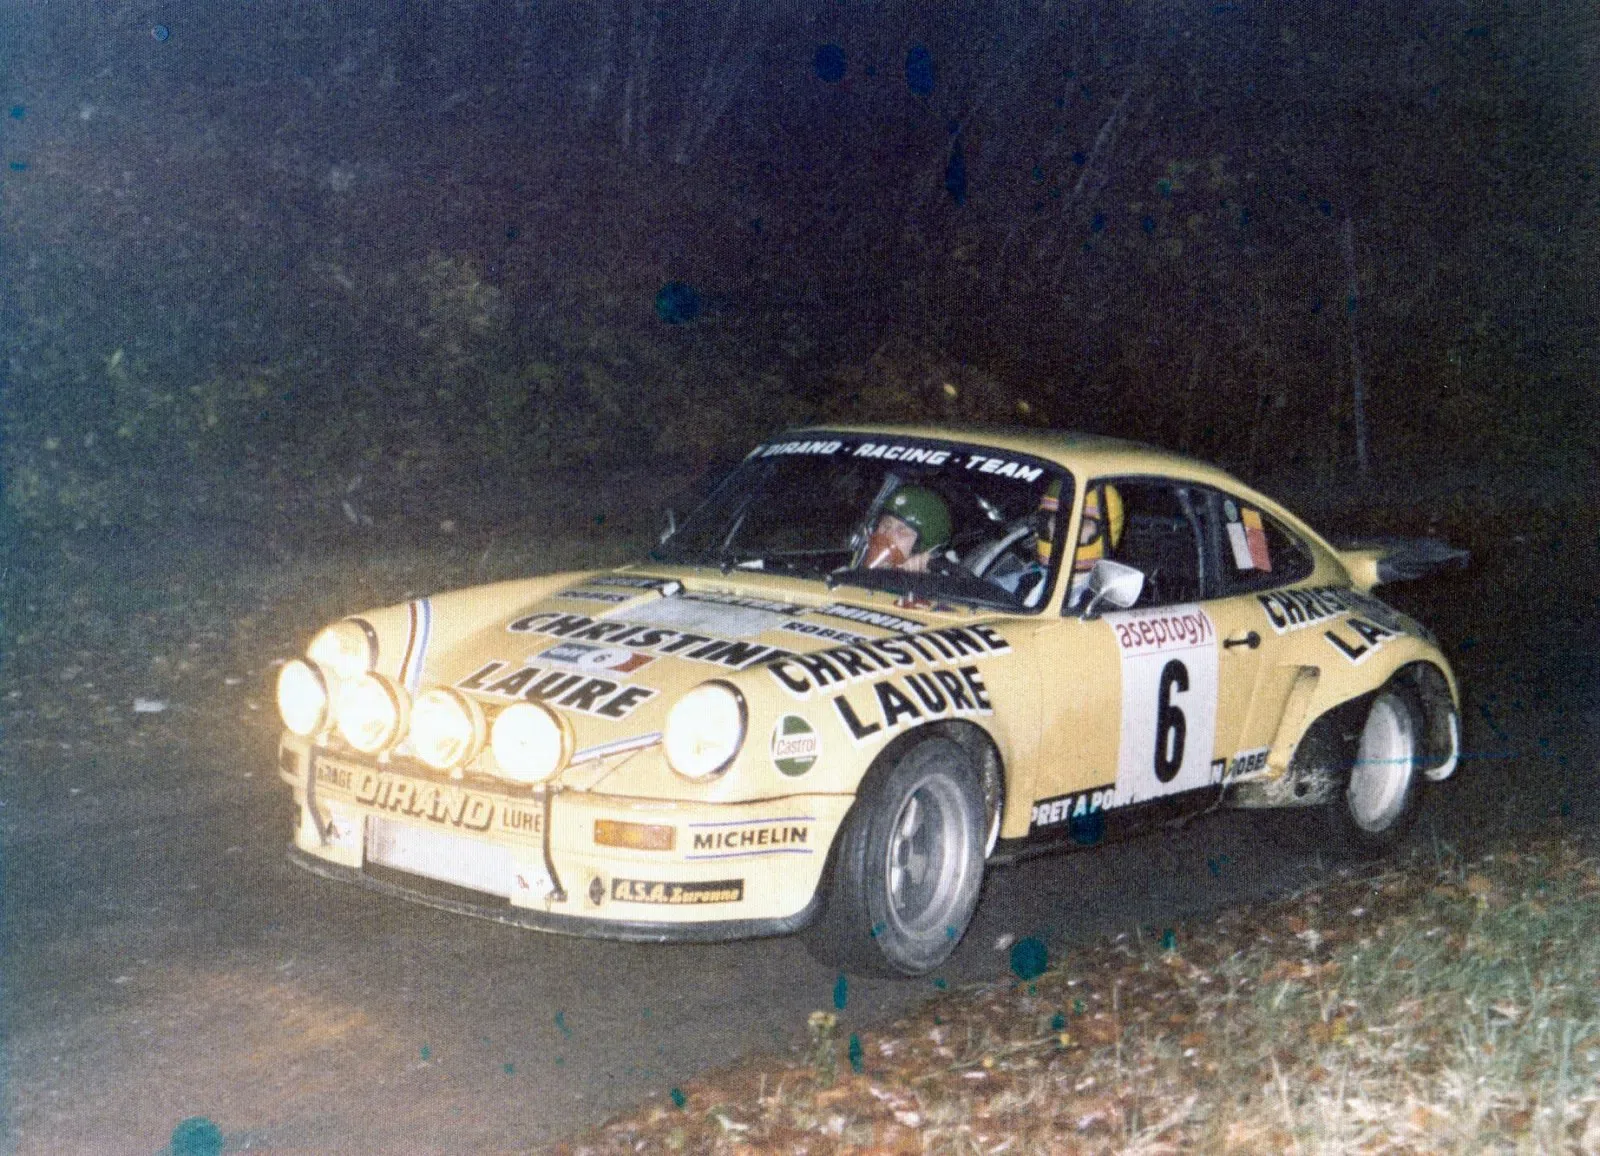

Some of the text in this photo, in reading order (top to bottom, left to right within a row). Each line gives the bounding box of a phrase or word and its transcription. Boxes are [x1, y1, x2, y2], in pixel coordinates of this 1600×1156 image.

[853, 443, 951, 466] RACING
[964, 454, 1044, 483] TEAM
[1115, 607, 1213, 649] aseptogyl
[767, 621, 1011, 696] CHRISTINE
[456, 660, 656, 718] LAURE
[833, 664, 994, 742] LAURE
[1154, 658, 1190, 784] 6
[775, 737, 817, 757] Castrol
[356, 772, 496, 832] DIRAND
[501, 806, 542, 835] LURE
[1072, 794, 1088, 818] A
[693, 826, 809, 850] MICHELIN
